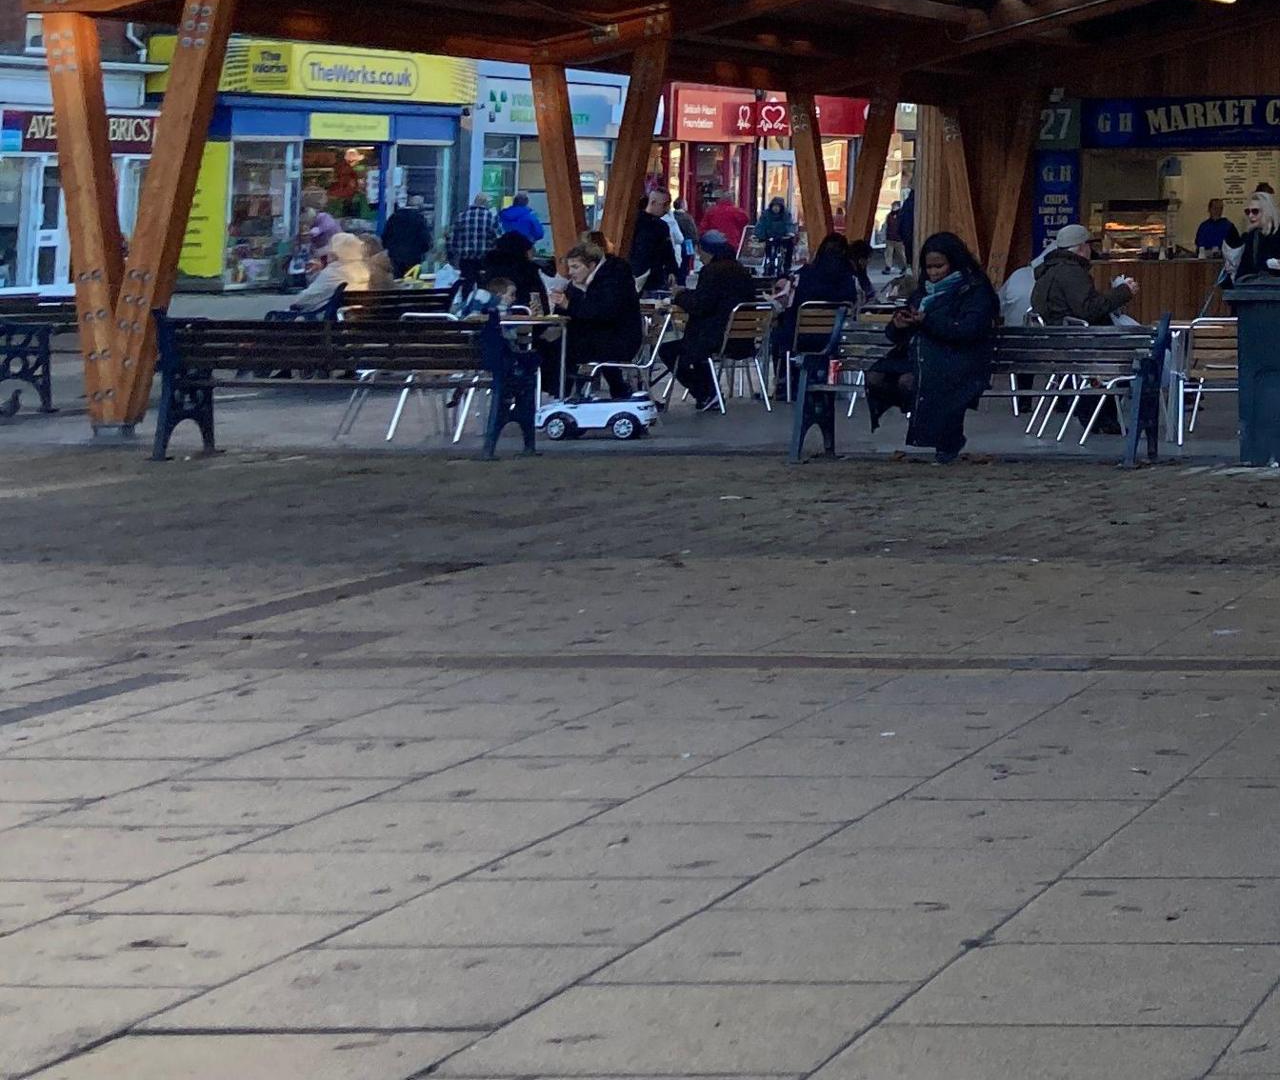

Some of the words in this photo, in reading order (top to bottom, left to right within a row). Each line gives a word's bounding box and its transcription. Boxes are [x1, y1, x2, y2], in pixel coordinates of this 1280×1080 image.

[260, 50, 282, 62] The
[309, 61, 412, 87] TheWorks.co.uk
[26, 115, 57, 139] AVE
[108, 118, 150, 141] BRICS
[1039, 107, 1073, 141] 27
[1097, 113, 1112, 133] G
[1118, 112, 1133, 133] H
[1144, 99, 1257, 135] MARKET
